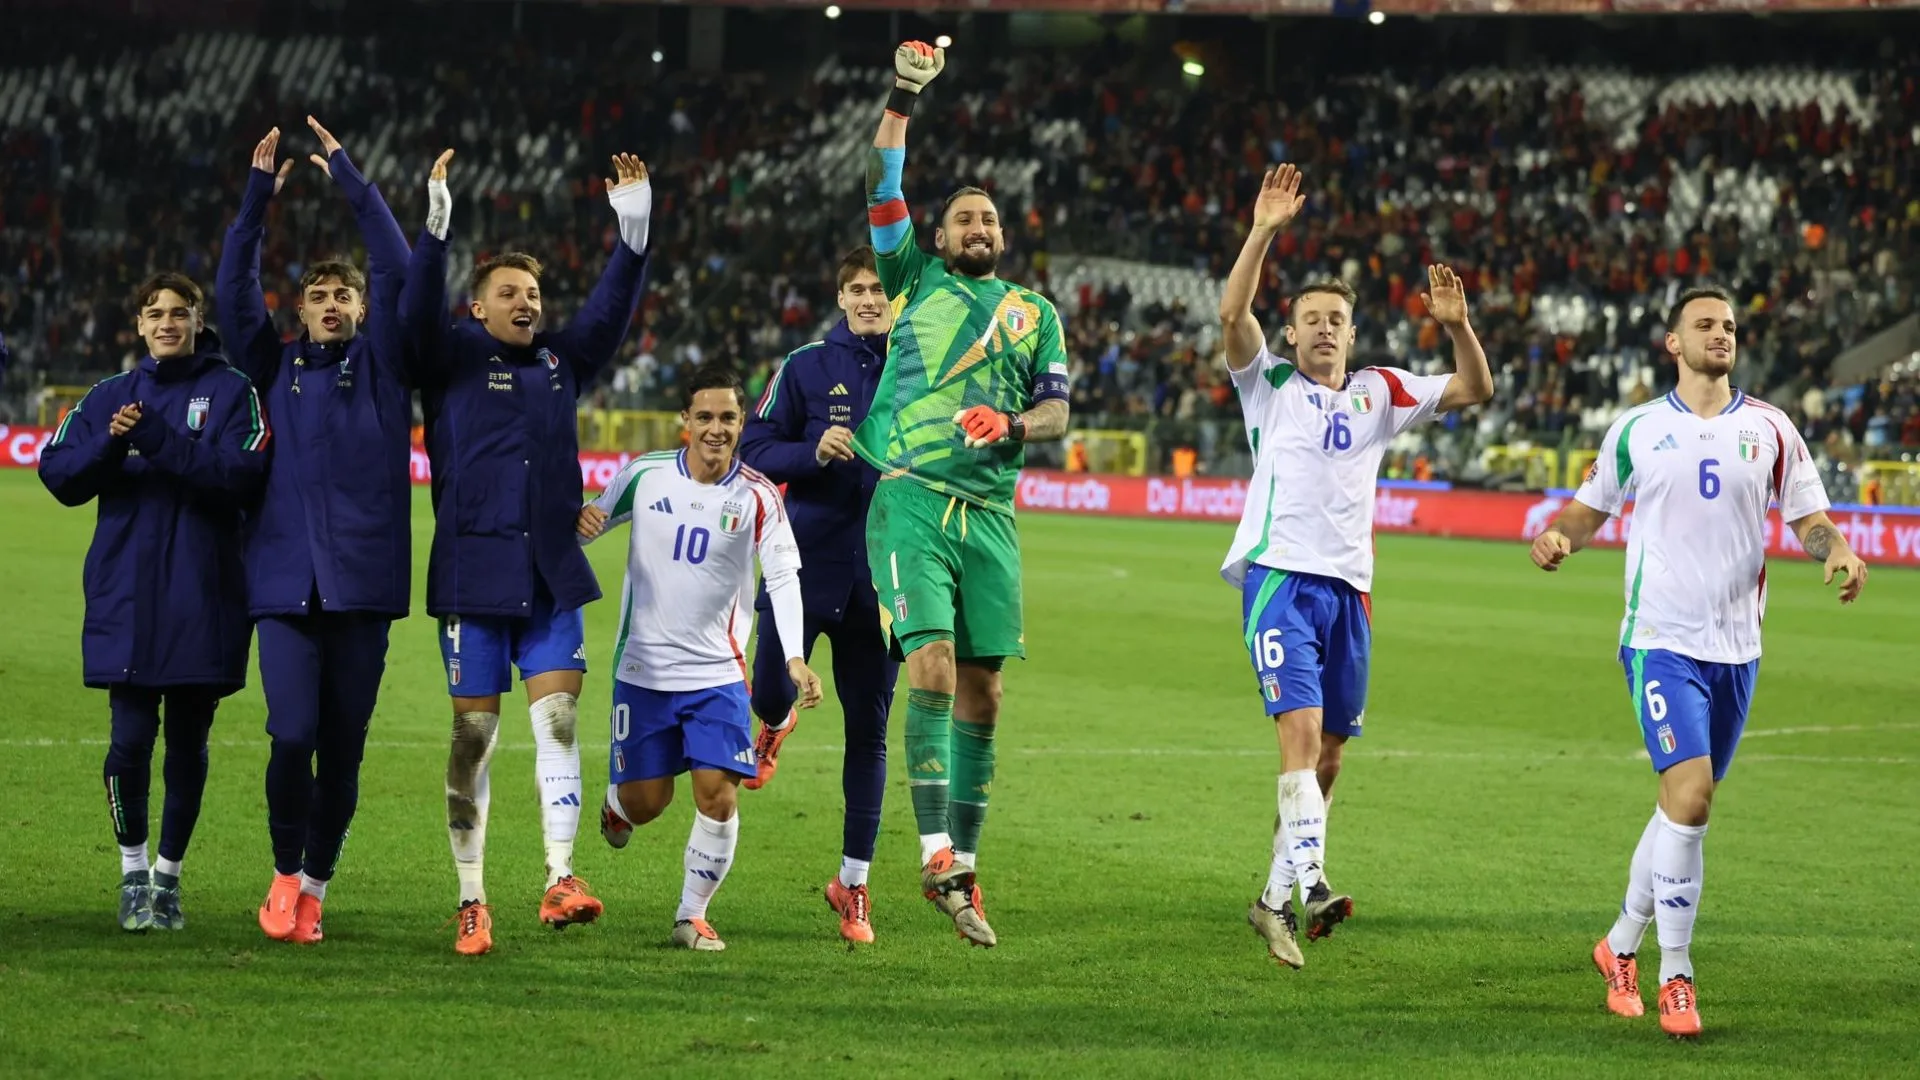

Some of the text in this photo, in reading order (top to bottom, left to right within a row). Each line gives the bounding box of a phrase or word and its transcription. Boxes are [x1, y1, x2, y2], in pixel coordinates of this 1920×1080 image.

[1323, 412, 1352, 450] 16
[1699, 458, 1720, 500] 6
[672, 523, 710, 565] 10
[889, 551, 900, 590] 1
[1254, 628, 1285, 672] 16
[1644, 680, 1668, 721] 6
[611, 703, 630, 743] 10
[688, 846, 727, 865] ITALIA
[1653, 871, 1692, 885] ITALIA
